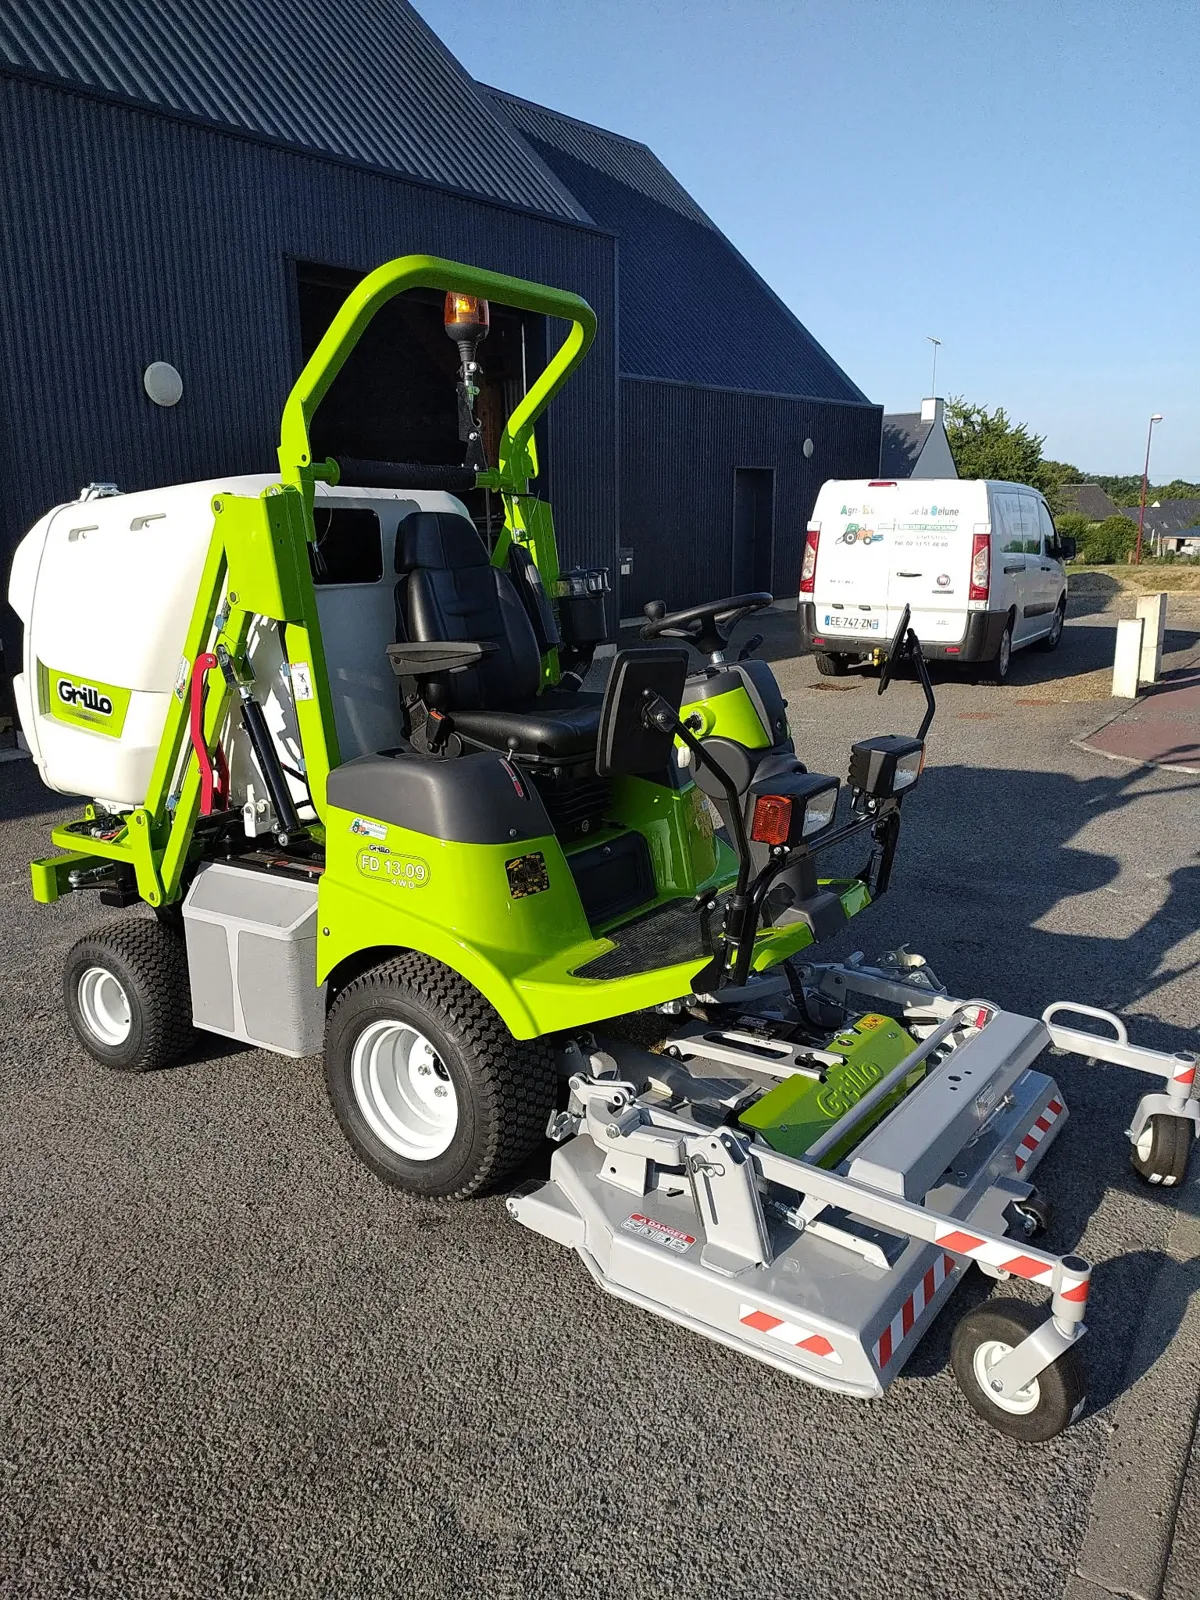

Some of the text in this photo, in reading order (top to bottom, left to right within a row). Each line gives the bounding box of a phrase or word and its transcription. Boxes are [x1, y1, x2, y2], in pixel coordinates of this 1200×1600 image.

[830, 616, 872, 628] EE-747-ZN
[58, 680, 113, 715] Grillo
[368, 844, 391, 854] Grillo
[361, 855, 425, 880] FD 13.09
[816, 1061, 884, 1119] Grillo
[647, 1219, 688, 1240] DANGER
